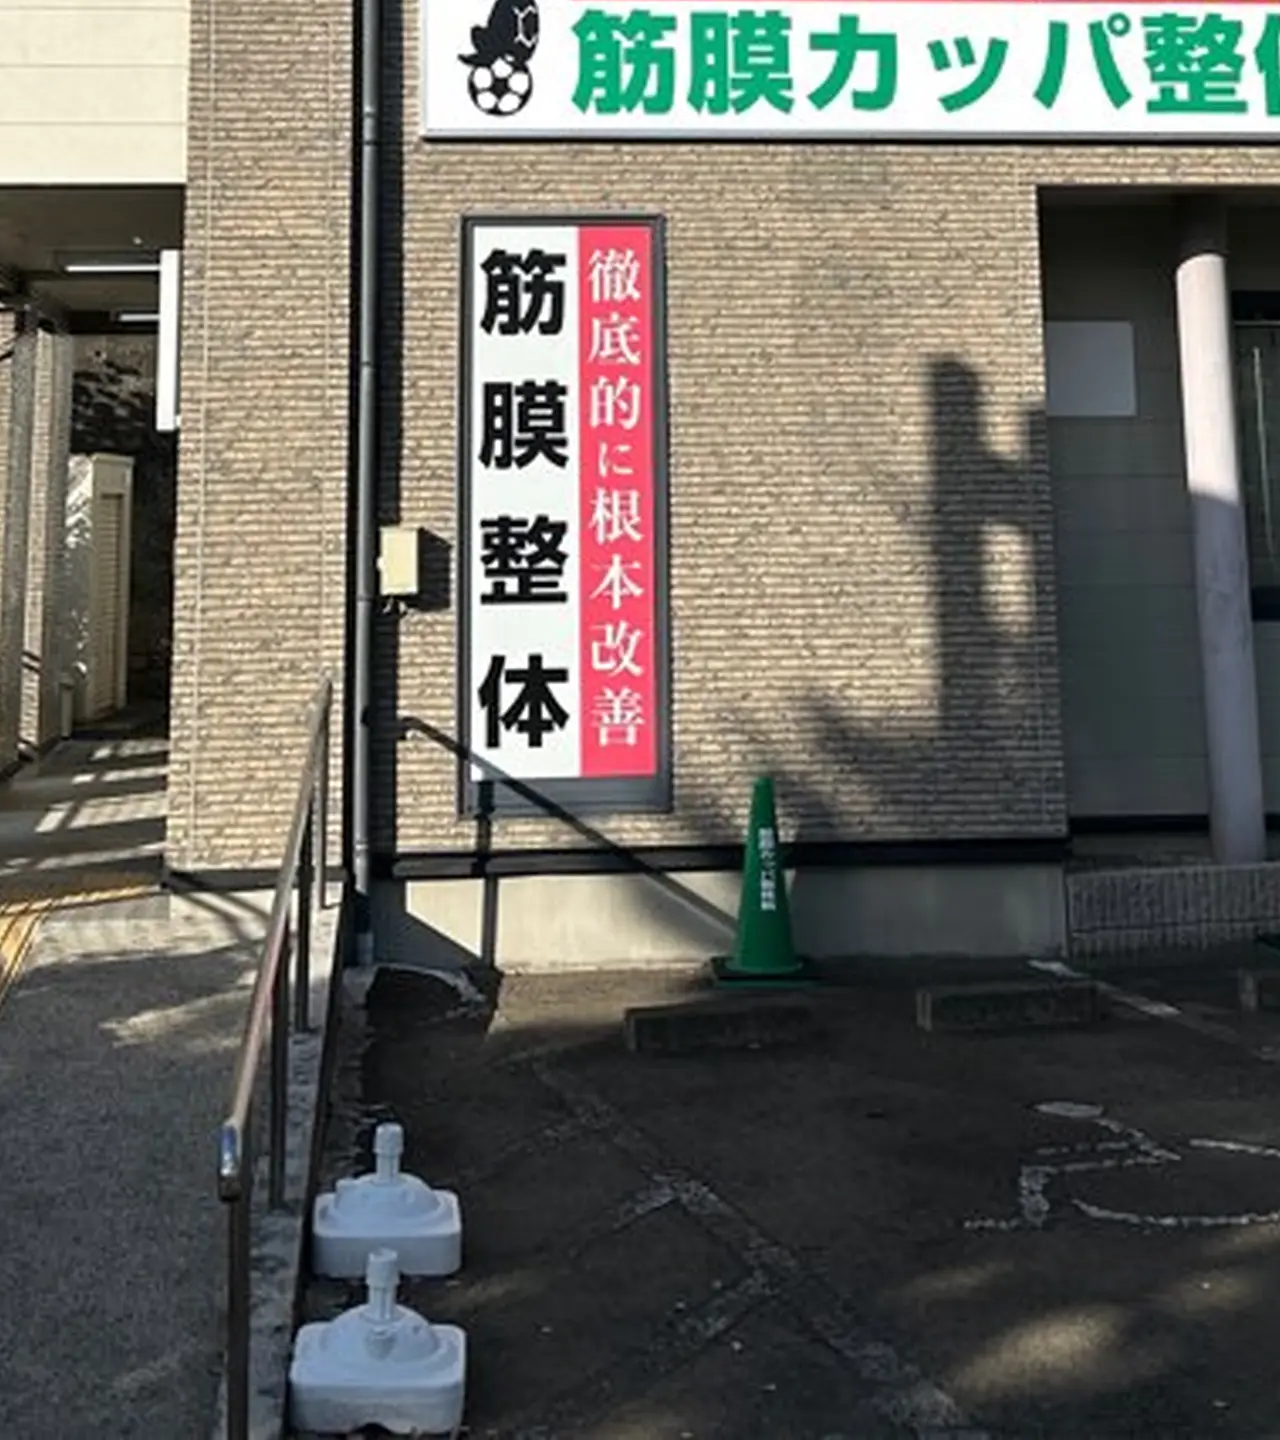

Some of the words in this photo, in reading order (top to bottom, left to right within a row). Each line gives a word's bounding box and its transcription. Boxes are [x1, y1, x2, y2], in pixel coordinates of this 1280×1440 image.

[478, 248, 570, 749] 筋膜整体
[588, 248, 646, 748] 徹底的に根本改善
